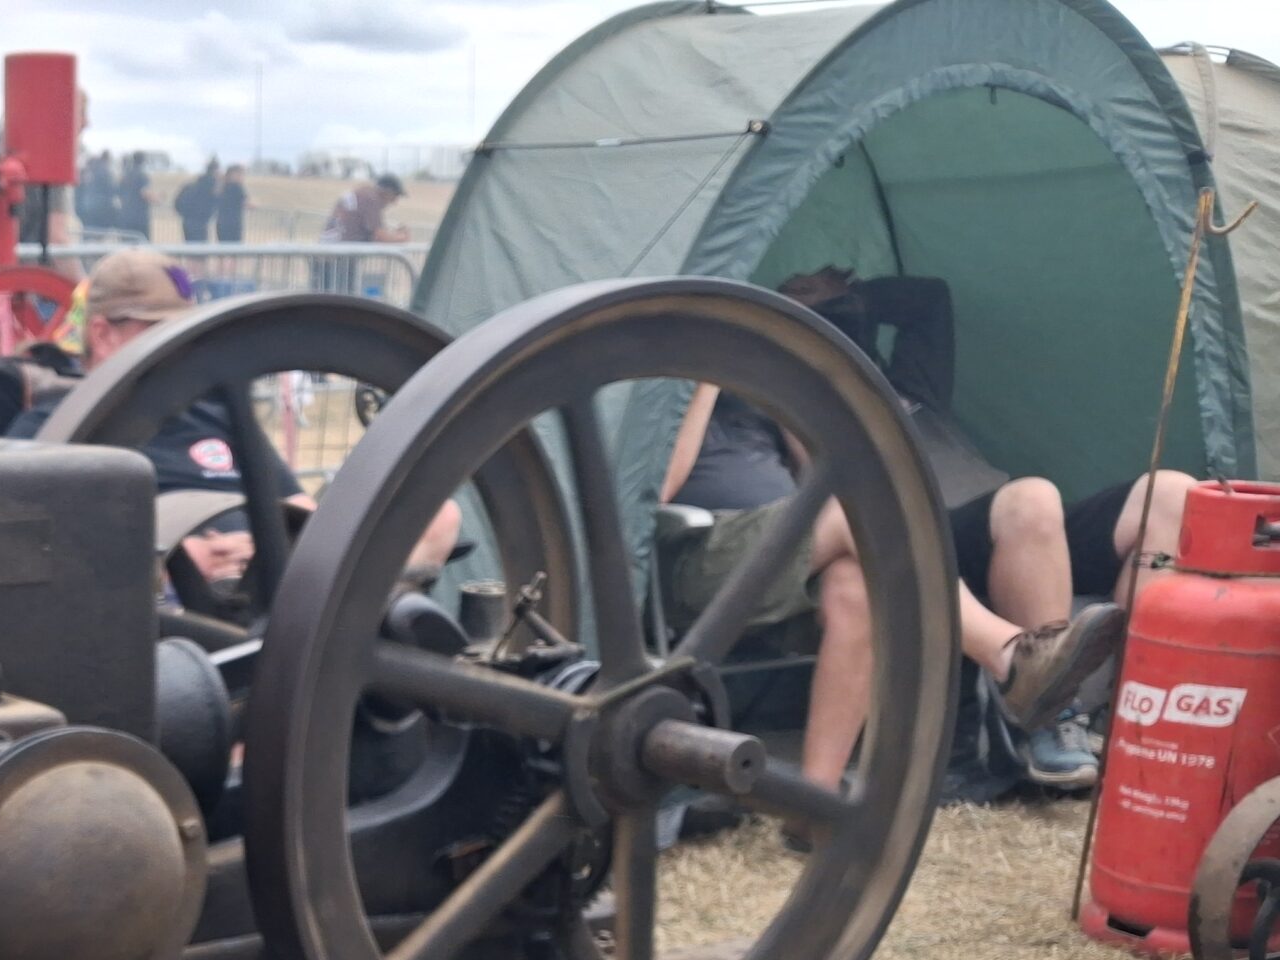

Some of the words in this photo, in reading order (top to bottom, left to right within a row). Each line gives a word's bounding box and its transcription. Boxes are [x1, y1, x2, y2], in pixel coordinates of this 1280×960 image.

[1123, 689, 1154, 715] FLO
[1176, 694, 1233, 717] GAS
[1157, 749, 1177, 764] UN
